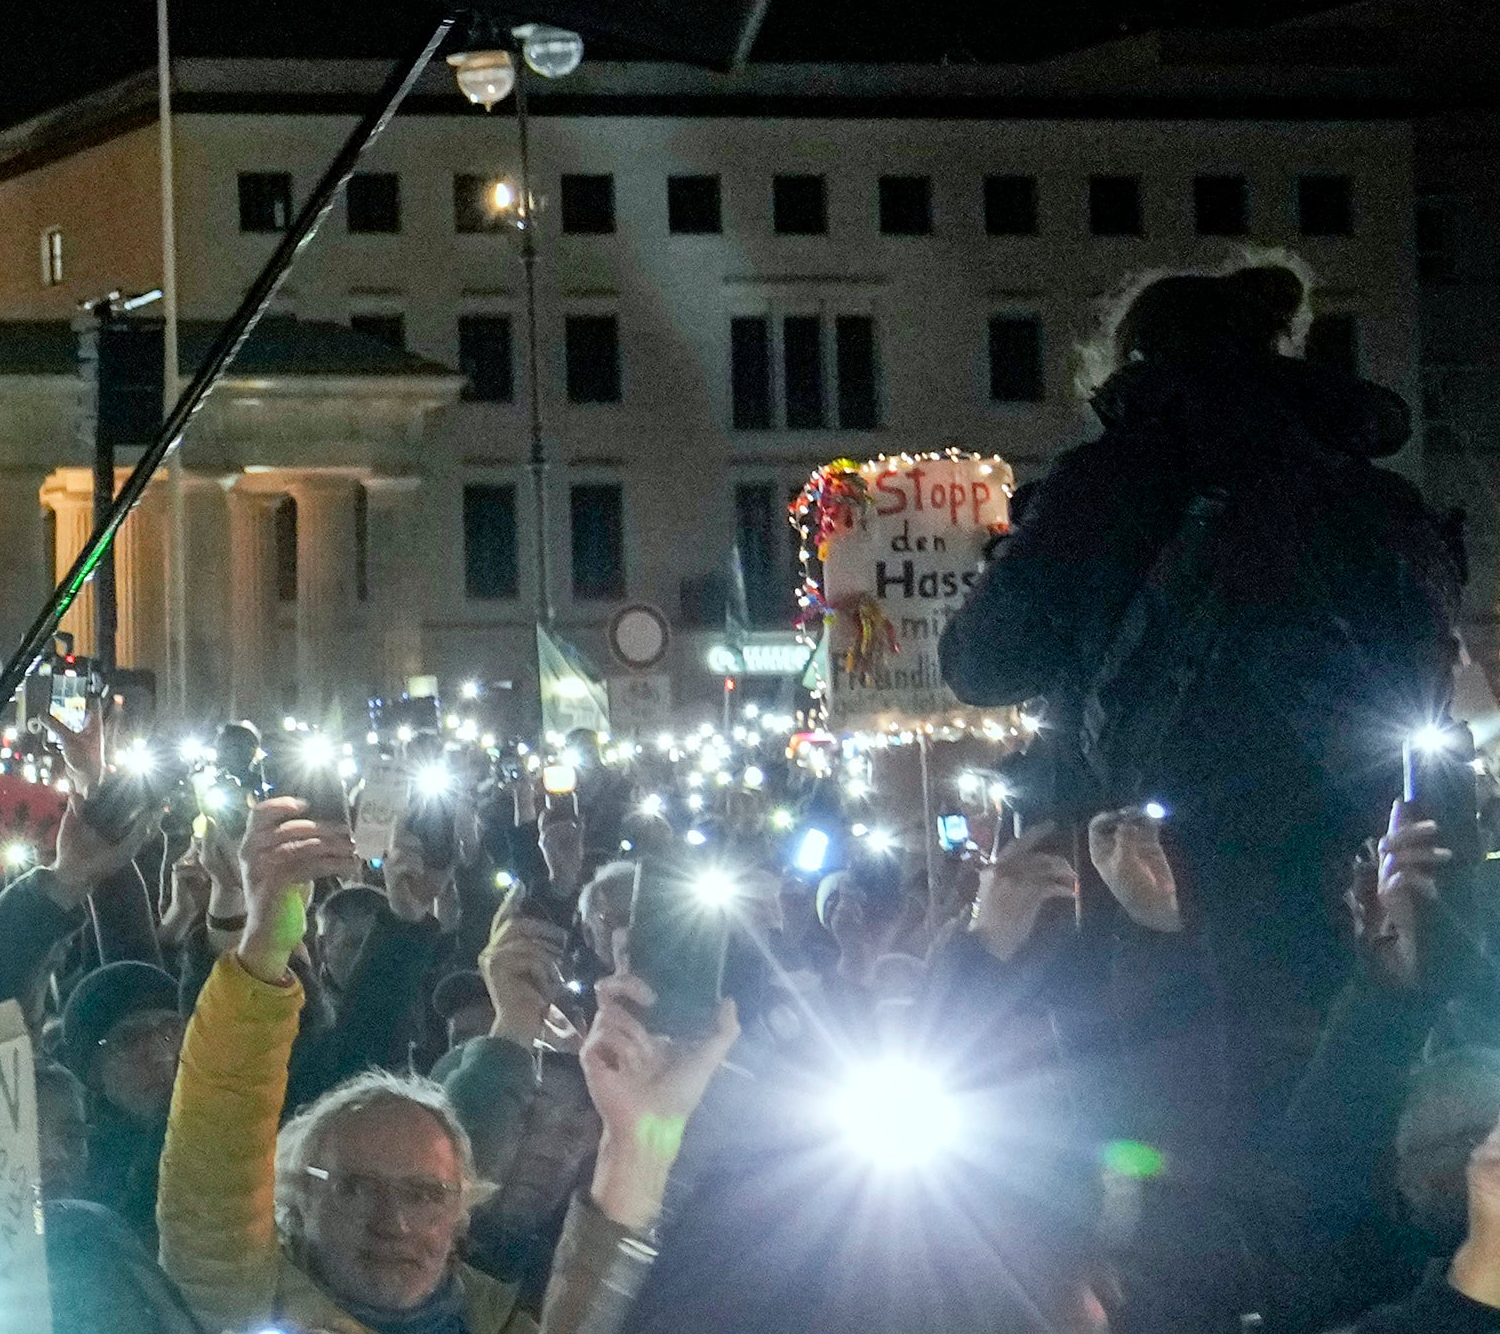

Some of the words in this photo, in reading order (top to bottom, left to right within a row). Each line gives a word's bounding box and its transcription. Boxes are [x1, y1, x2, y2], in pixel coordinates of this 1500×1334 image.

[891, 520, 946, 553] den
[875, 559, 975, 599] Hass
[901, 607, 940, 639] mi
